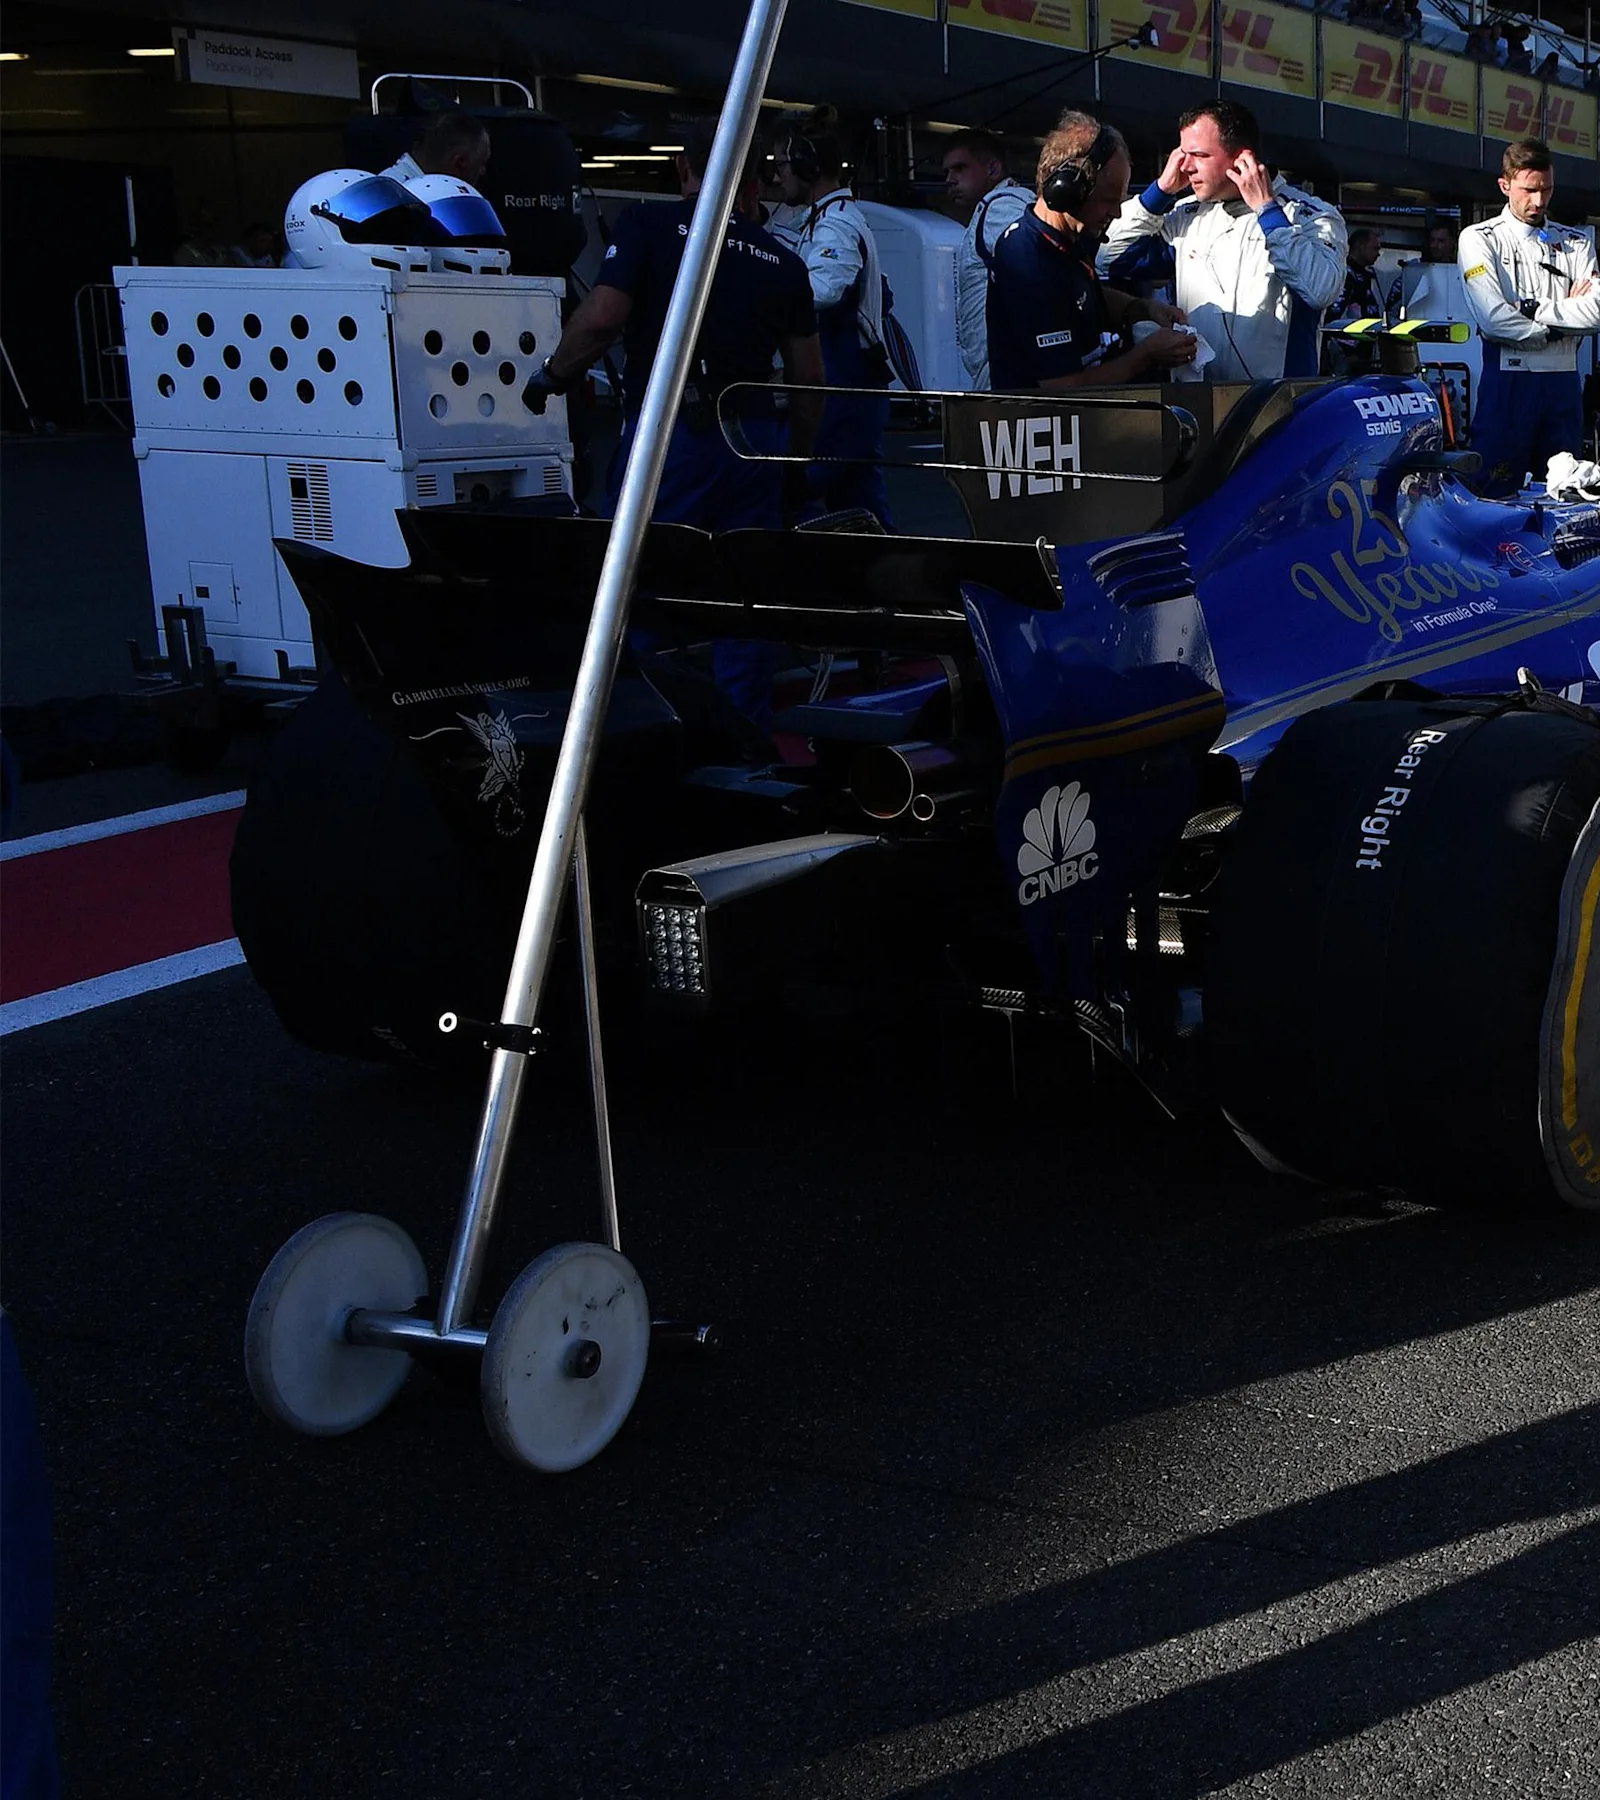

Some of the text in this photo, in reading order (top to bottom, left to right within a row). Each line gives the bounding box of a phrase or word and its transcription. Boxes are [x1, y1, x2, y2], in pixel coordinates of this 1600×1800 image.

[204, 42, 293, 62] Paddock Access
[1143, 0, 1281, 76] DHL
[1353, 42, 1451, 114] DHL
[1503, 84, 1578, 145] DHL
[504, 193, 566, 209] Rear Right
[747, 243, 780, 265] Team
[1353, 391, 1435, 420] POWER
[979, 414, 1082, 500] WEH
[1327, 478, 1409, 568] 25
[1290, 550, 1500, 643] Years
[1410, 619, 1429, 633] in
[1422, 606, 1474, 629] Formula
[1355, 729, 1448, 870] Rear Right
[1018, 852, 1099, 905] CNBC
